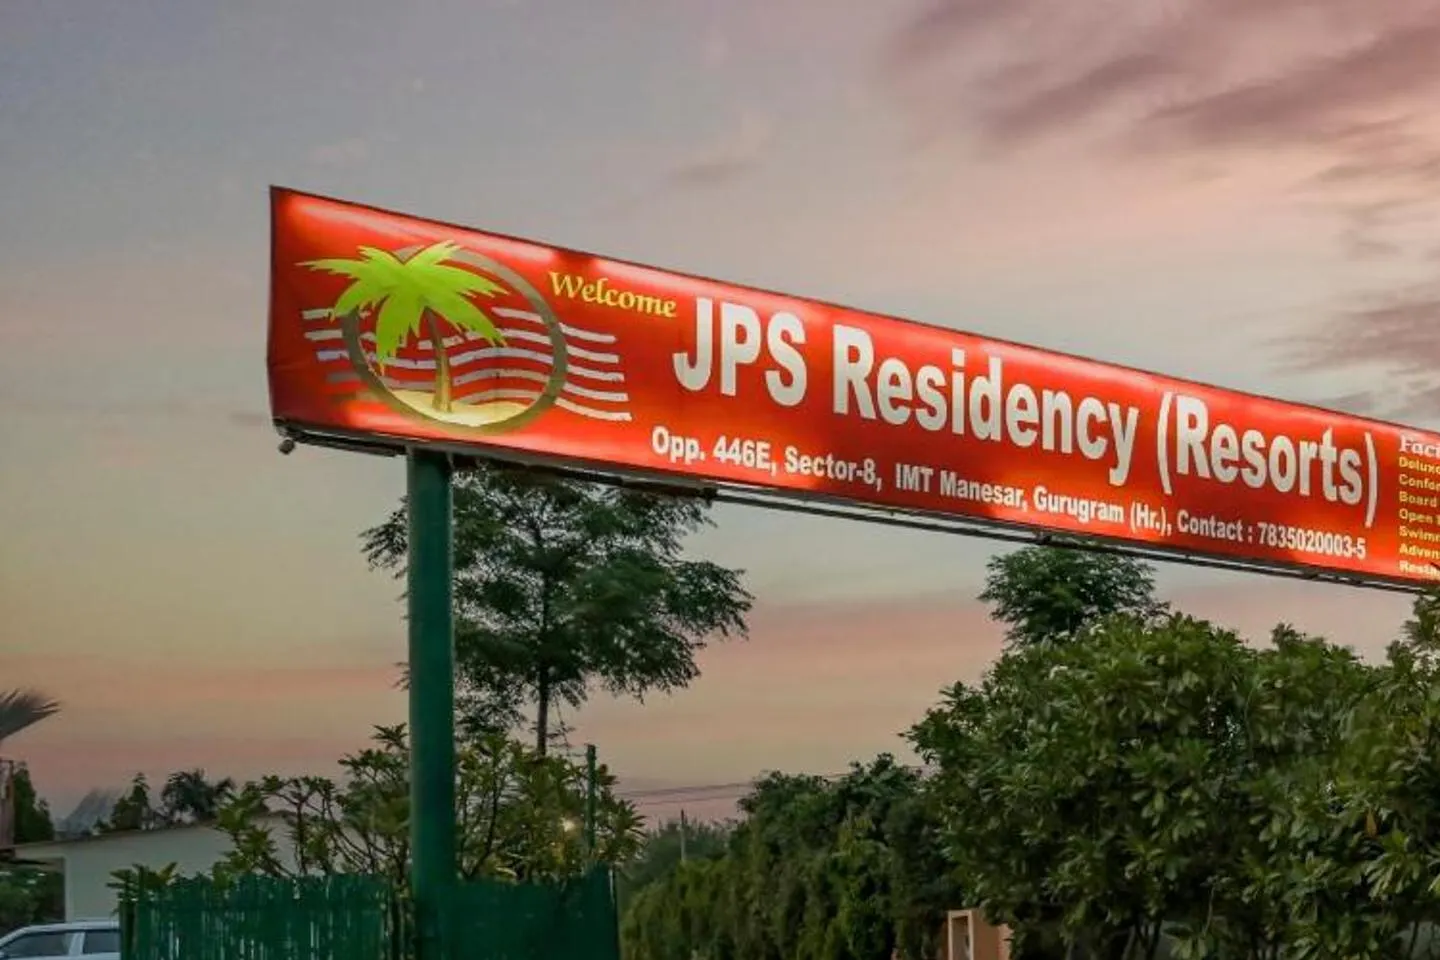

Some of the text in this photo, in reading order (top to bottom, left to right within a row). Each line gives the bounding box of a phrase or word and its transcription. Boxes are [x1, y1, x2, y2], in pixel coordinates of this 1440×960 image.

[548, 271, 677, 317] Welcome
[672, 298, 1378, 529] JPS Residency (Resorts)
[652, 426, 705, 465] Opp.
[712, 434, 777, 477] 446E,
[784, 445, 882, 491] Sector-8,
[895, 463, 934, 493] IMT
[940, 470, 1028, 513] Manesar,
[1033, 485, 1124, 524] Gurugram
[1177, 509, 1244, 542] Contact
[1257, 521, 1367, 560] 7835020003-5
[1399, 491, 1437, 508] Board
[1399, 508, 1433, 523] Open
